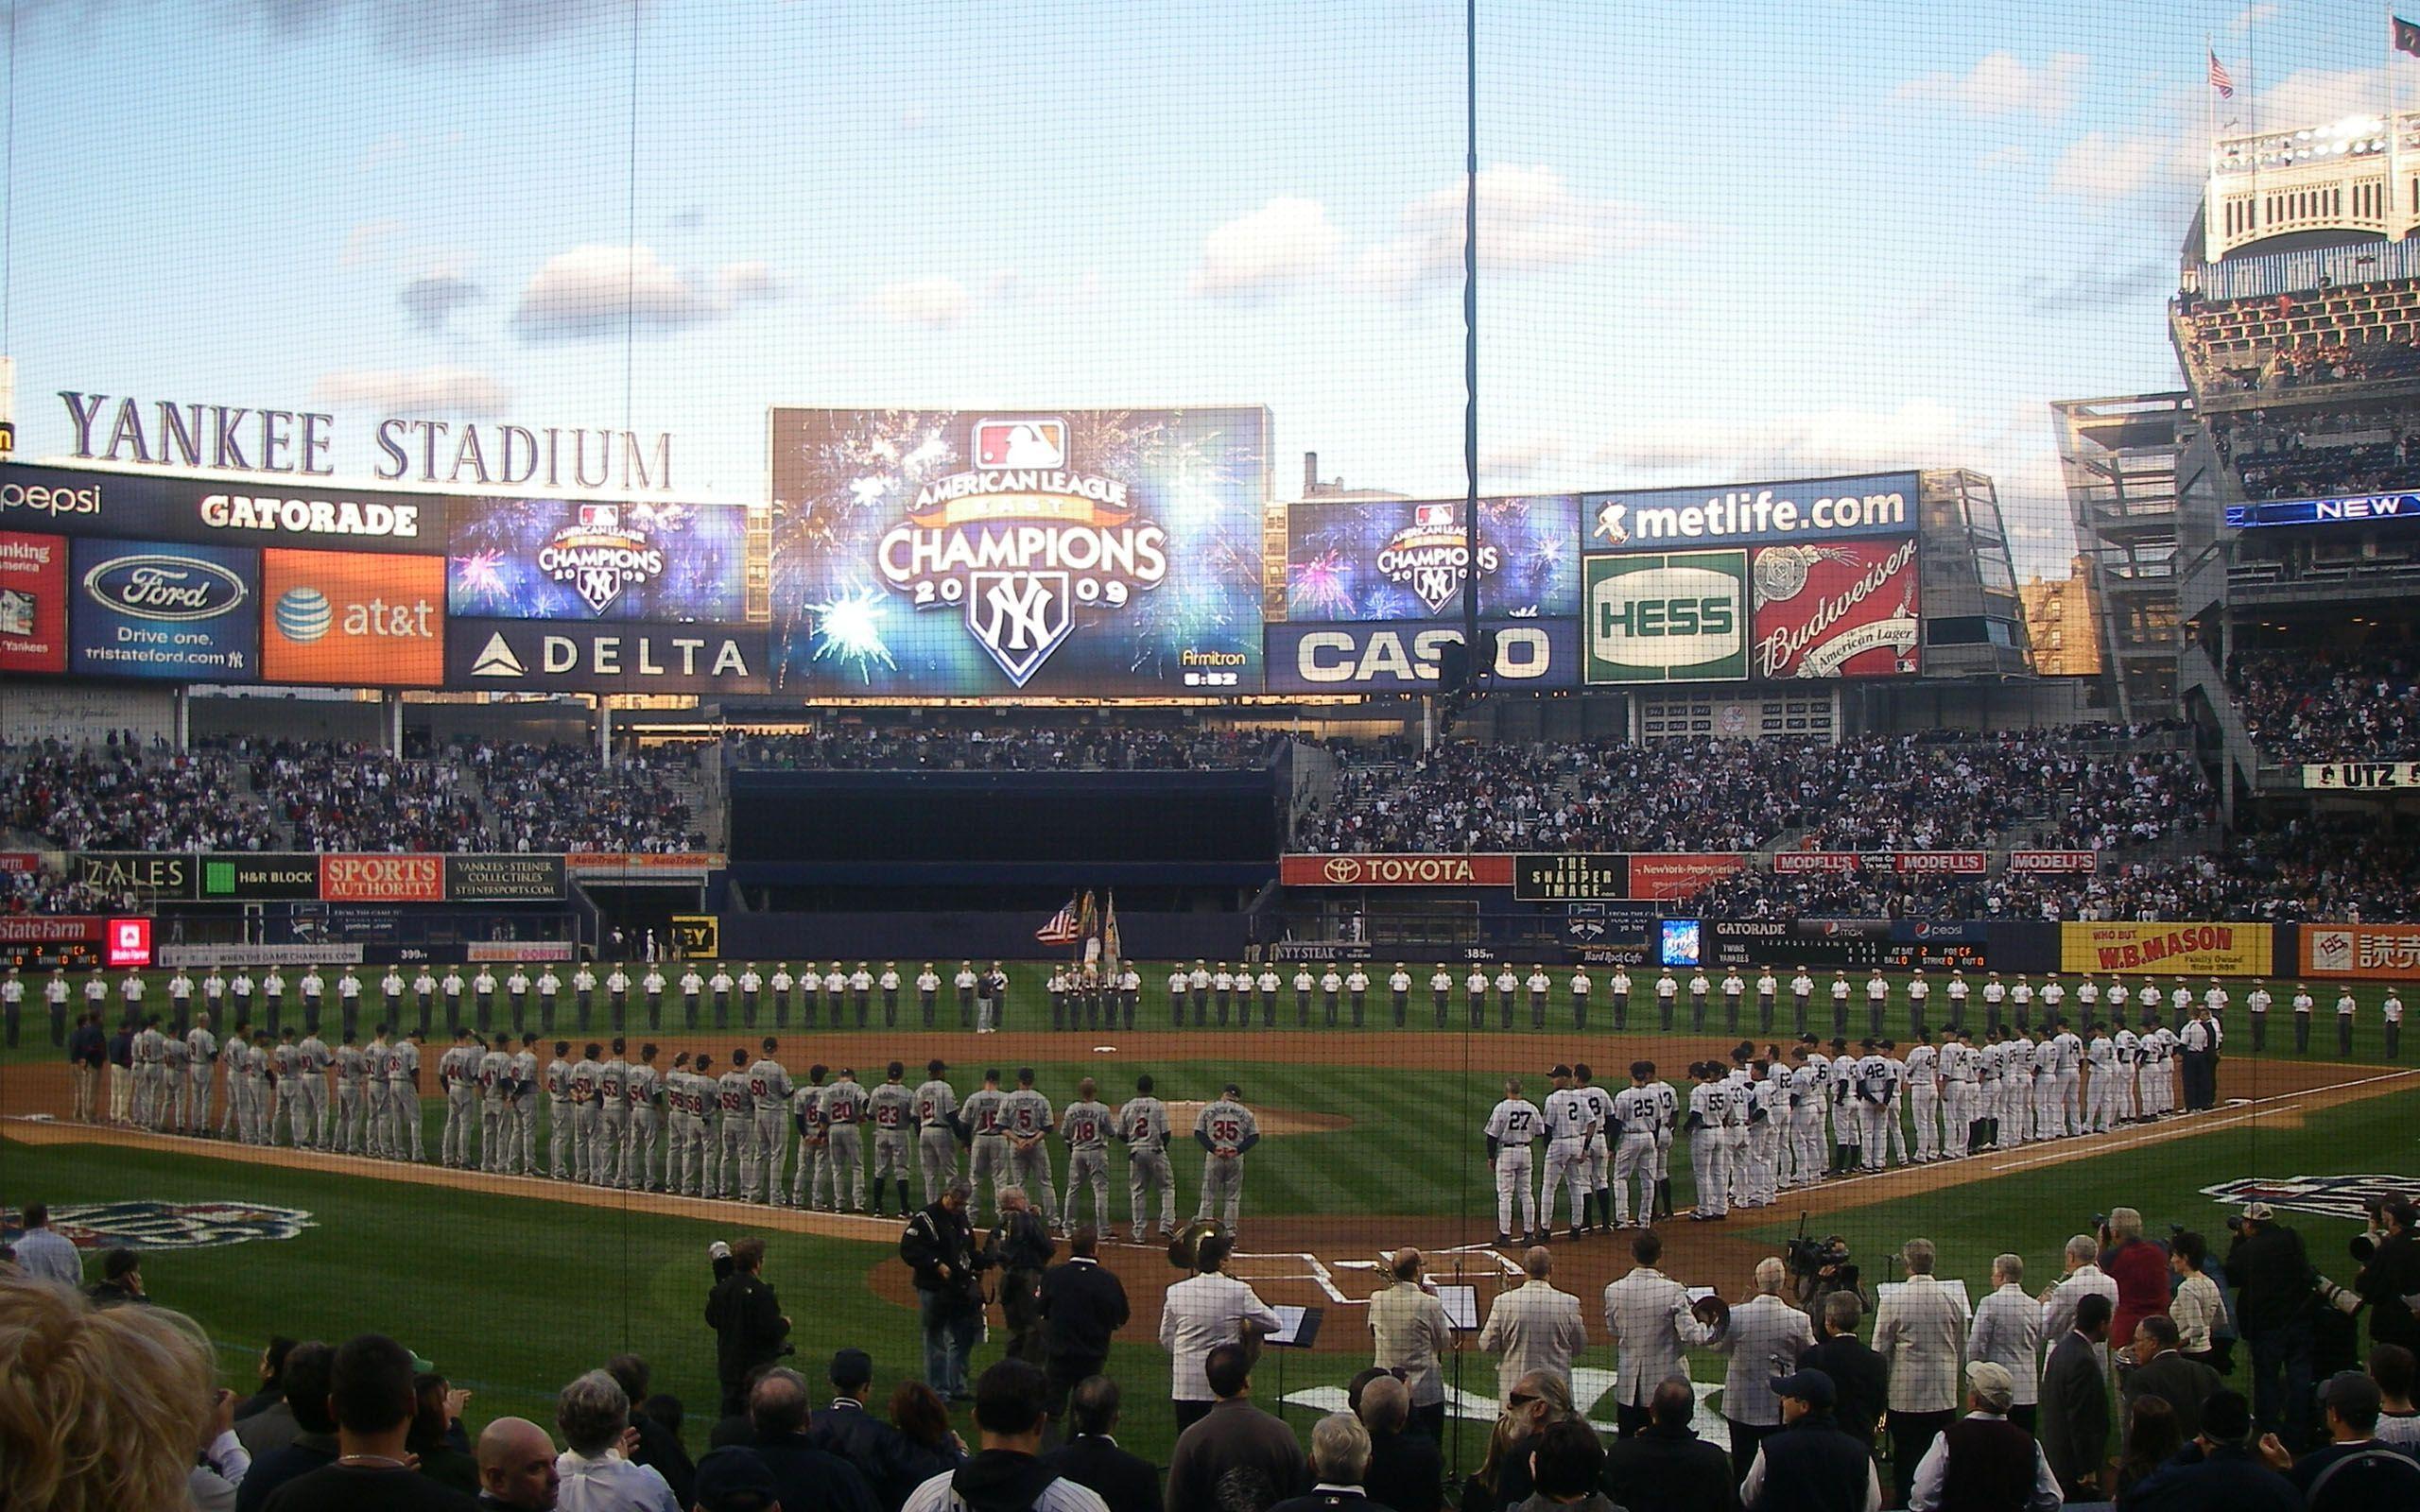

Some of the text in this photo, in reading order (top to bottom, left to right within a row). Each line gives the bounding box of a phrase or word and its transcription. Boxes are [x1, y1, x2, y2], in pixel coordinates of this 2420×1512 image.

[57, 390, 674, 491] YANKEE STADIUM
[914, 471, 1128, 510] AMERICAN LEAGUE
[0, 483, 102, 518] pepsi
[974, 497, 1063, 514] EAST
[2316, 498, 2400, 520] NEW
[201, 495, 418, 537] GATORADE
[1635, 490, 1905, 540] metlife.com
[555, 524, 646, 543] AMERICAN LEAGUE
[1392, 525, 1481, 544] AMERICAN LEAG
[539, 547, 663, 576] CHAMPIONS
[879, 526, 1167, 584] CHAMPIONS
[0, 561, 40, 573] merica
[554, 570, 575, 582] 20
[1392, 571, 1411, 582] 20
[123, 567, 210, 608] Ford
[914, 577, 963, 605] 20
[1076, 576, 1130, 604] 09
[343, 598, 434, 639] at&t
[1601, 597, 1733, 639] HESS
[1754, 538, 1917, 680] Budweiser
[117, 627, 214, 646] Drive one.
[6, 641, 48, 654] Yankees
[85, 646, 225, 665] tristateford.com
[544, 634, 749, 677] DELTA
[1298, 627, 1550, 682] CASO
[1819, 633, 1873, 668] American
[1876, 628, 1913, 642] Lager
[1183, 649, 1246, 666] Armitron
[2343, 764, 2396, 787] UTZ
[329, 858, 437, 882] SPORTS
[1366, 859, 1477, 882] TOYOTA
[1557, 856, 1587, 869] THE
[1781, 855, 1854, 869] MODELL'S
[1904, 855, 1979, 869] MODELL'S
[2014, 854, 2094, 868] MODELL'S
[87, 860, 183, 886] ZALES
[239, 871, 314, 884] H&R BLOCK
[1531, 870, 1612, 884] SHARPER
[330, 881, 436, 896] AUTHORITY
[43, 919, 86, 939] Farm
[1717, 922, 1786, 935] GATORADE
[2092, 930, 2137, 940] WHO BUT
[1583, 951, 1605, 962] Hard
[1624, 952, 1643, 964] Cafe
[1865, 1062, 1886, 1079] 42
[1925, 1054, 1937, 1070] 40
[603, 1080, 618, 1097] 53
[751, 1078, 768, 1097] 60
[722, 1092, 740, 1110] 59
[831, 1101, 852, 1120] 20
[921, 1100, 936, 1119] 21
[1634, 1098, 1654, 1118] 25
[1708, 1093, 1724, 1111] 55
[877, 1105, 899, 1124] 23
[1018, 1108, 1032, 1129] 5
[1509, 1110, 1532, 1131] 27
[1568, 1101, 1578, 1121] 2
[1072, 1121, 1095, 1141] 18
[1134, 1117, 1149, 1138] 2
[1212, 1120, 1240, 1141] 35
